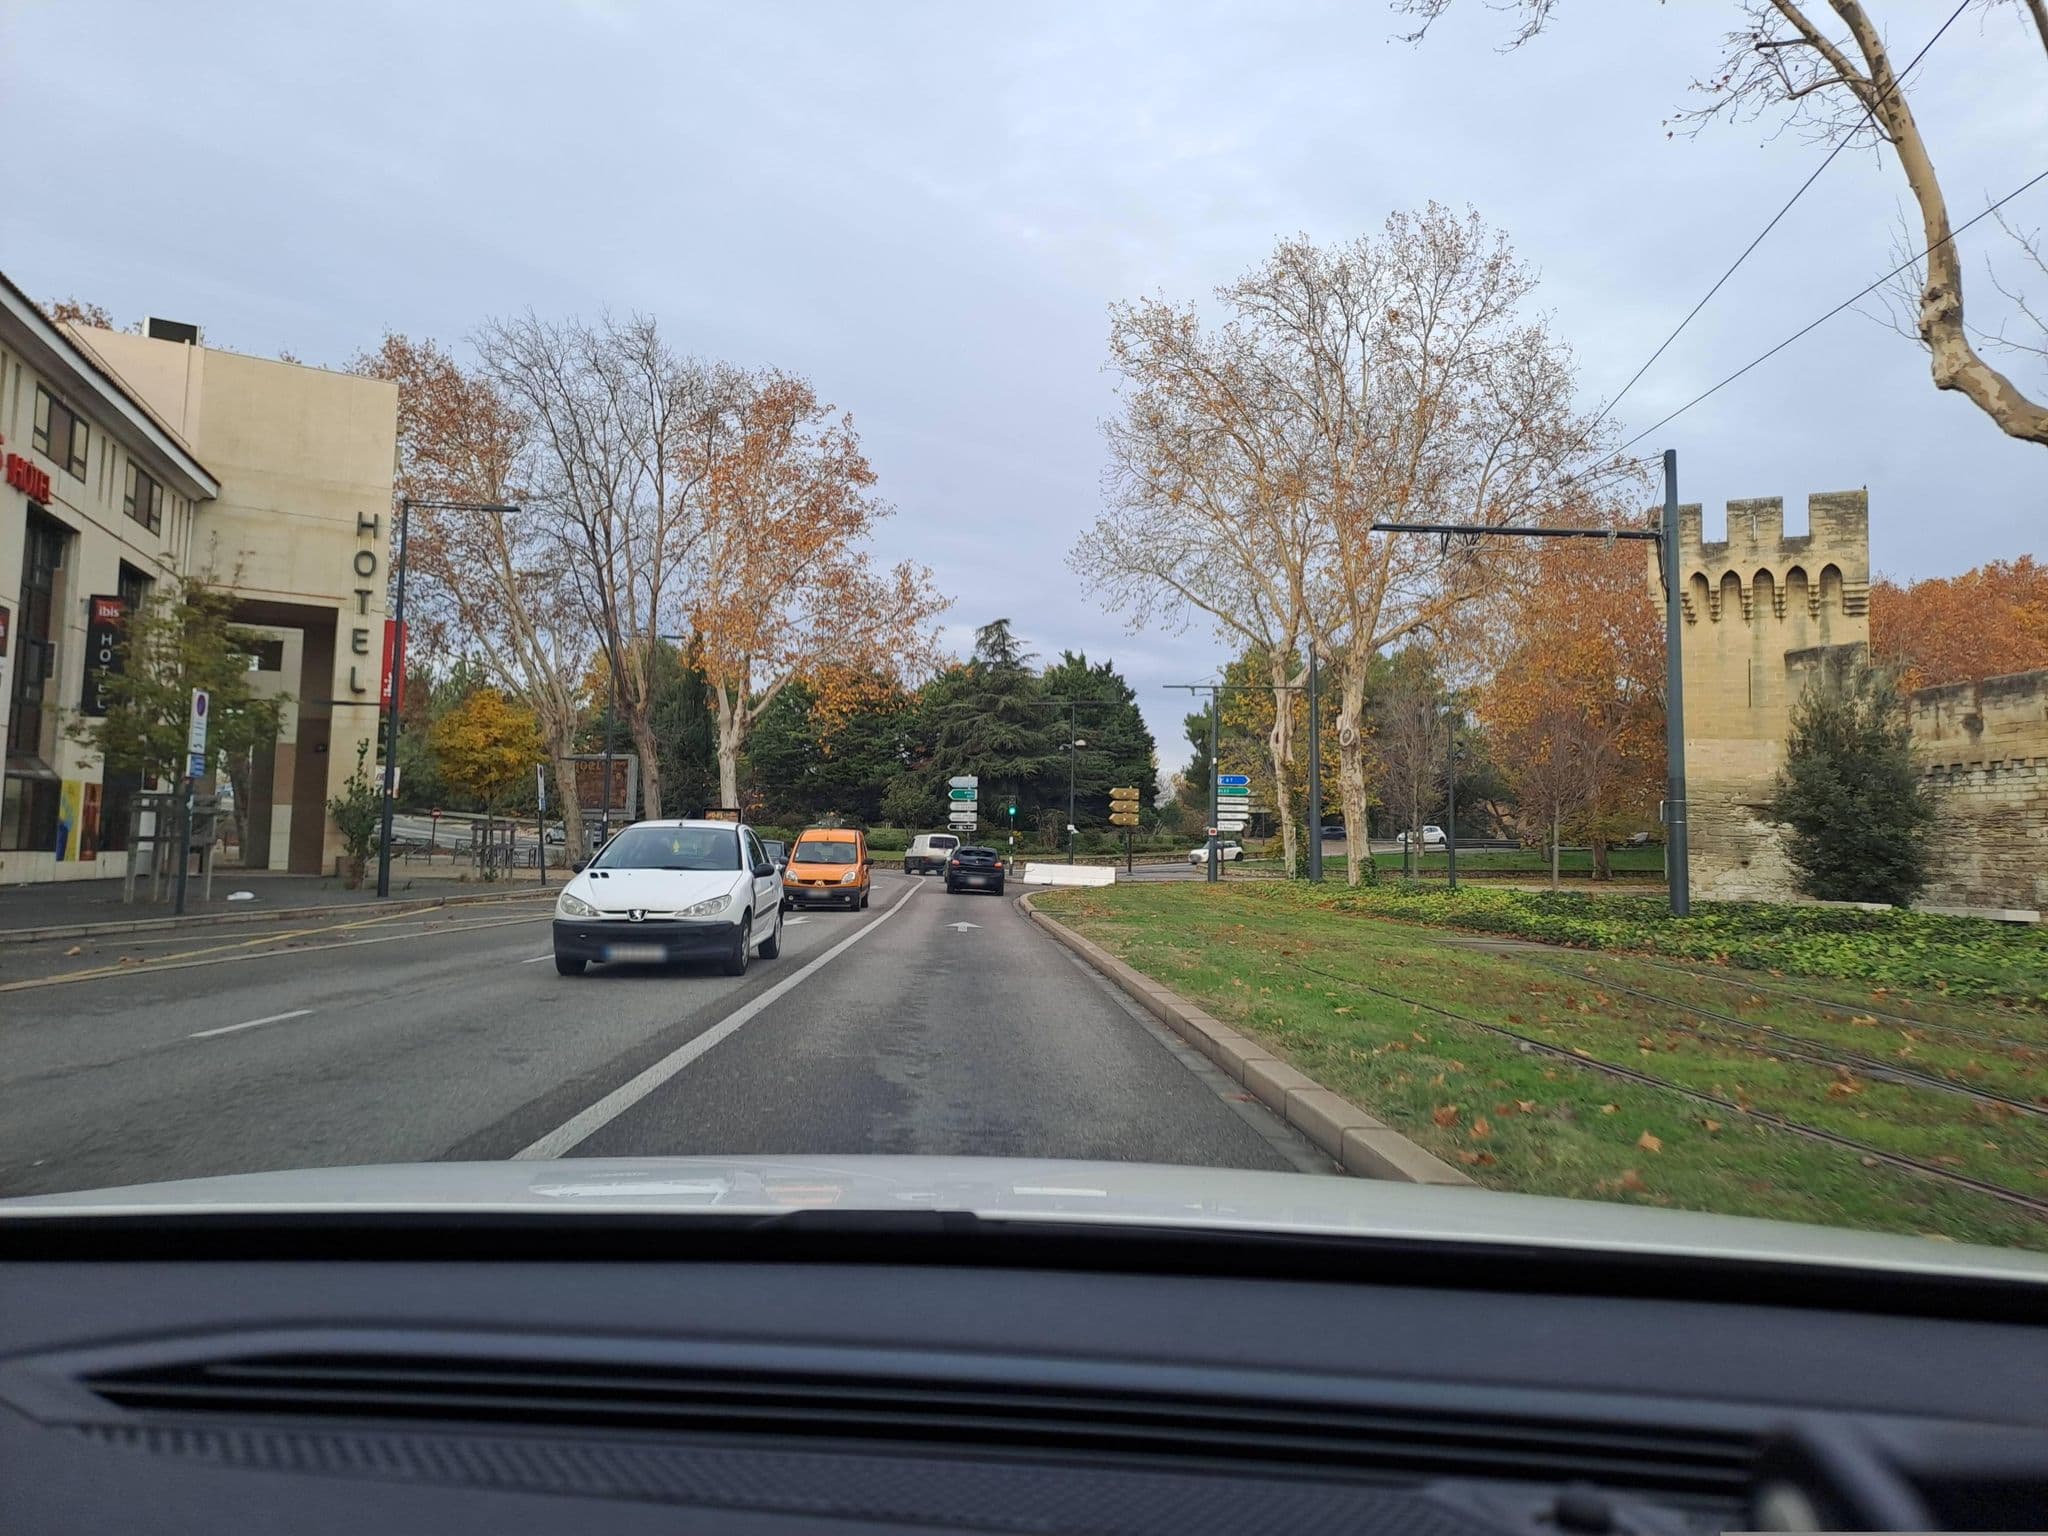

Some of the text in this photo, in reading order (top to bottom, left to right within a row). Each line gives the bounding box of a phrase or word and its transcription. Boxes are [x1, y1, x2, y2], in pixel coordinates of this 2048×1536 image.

[98, 605, 120, 617] ibis
[351, 512, 378, 694] HOTEL
[97, 633, 112, 710] HOTEL
